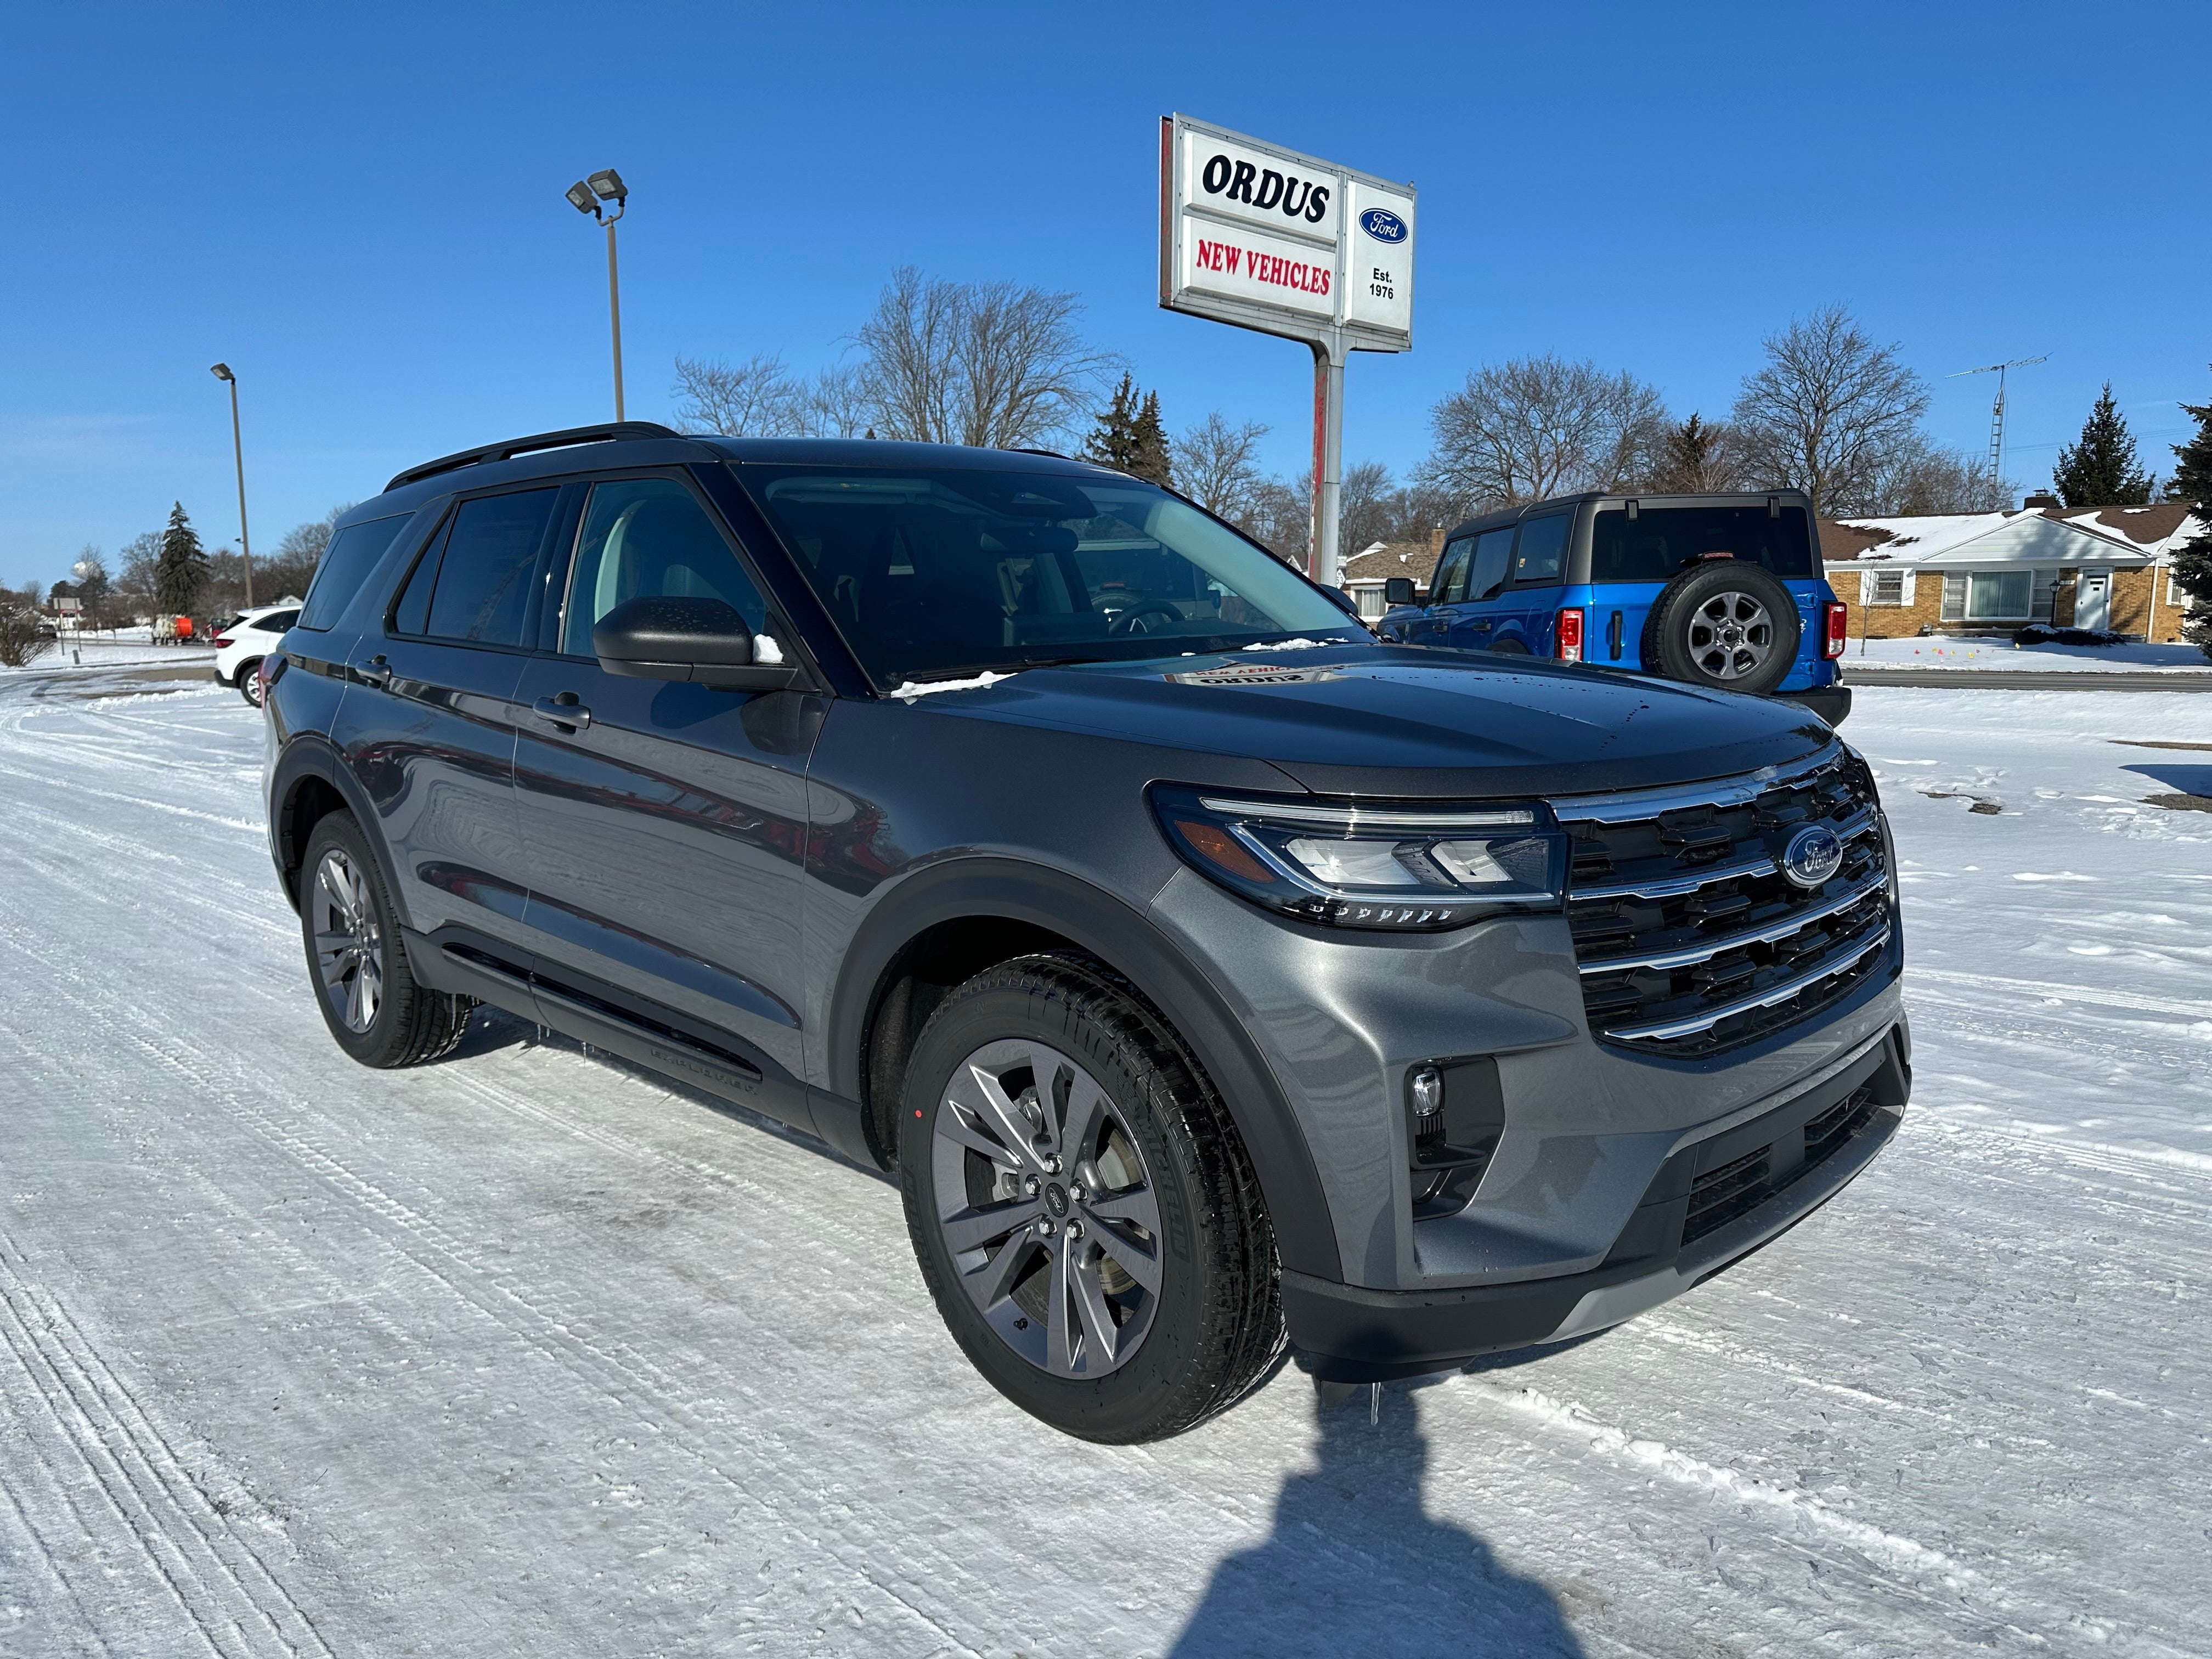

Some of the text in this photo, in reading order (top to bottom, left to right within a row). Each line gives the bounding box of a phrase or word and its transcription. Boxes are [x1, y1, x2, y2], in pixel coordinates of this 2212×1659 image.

[1203, 155, 1330, 223] ORDUS
[1370, 213, 1398, 238] Ford
[1197, 239, 1331, 296] NEW VEHICLES
[1373, 268, 1392, 283] Est.
[1369, 284, 1394, 300] 1976
[1805, 838, 1835, 873] Ford
[1050, 1192, 1062, 1208] Ford
[1135, 1118, 1187, 1255] MICHELIN
[905, 1169, 944, 1288] MICHELIN
